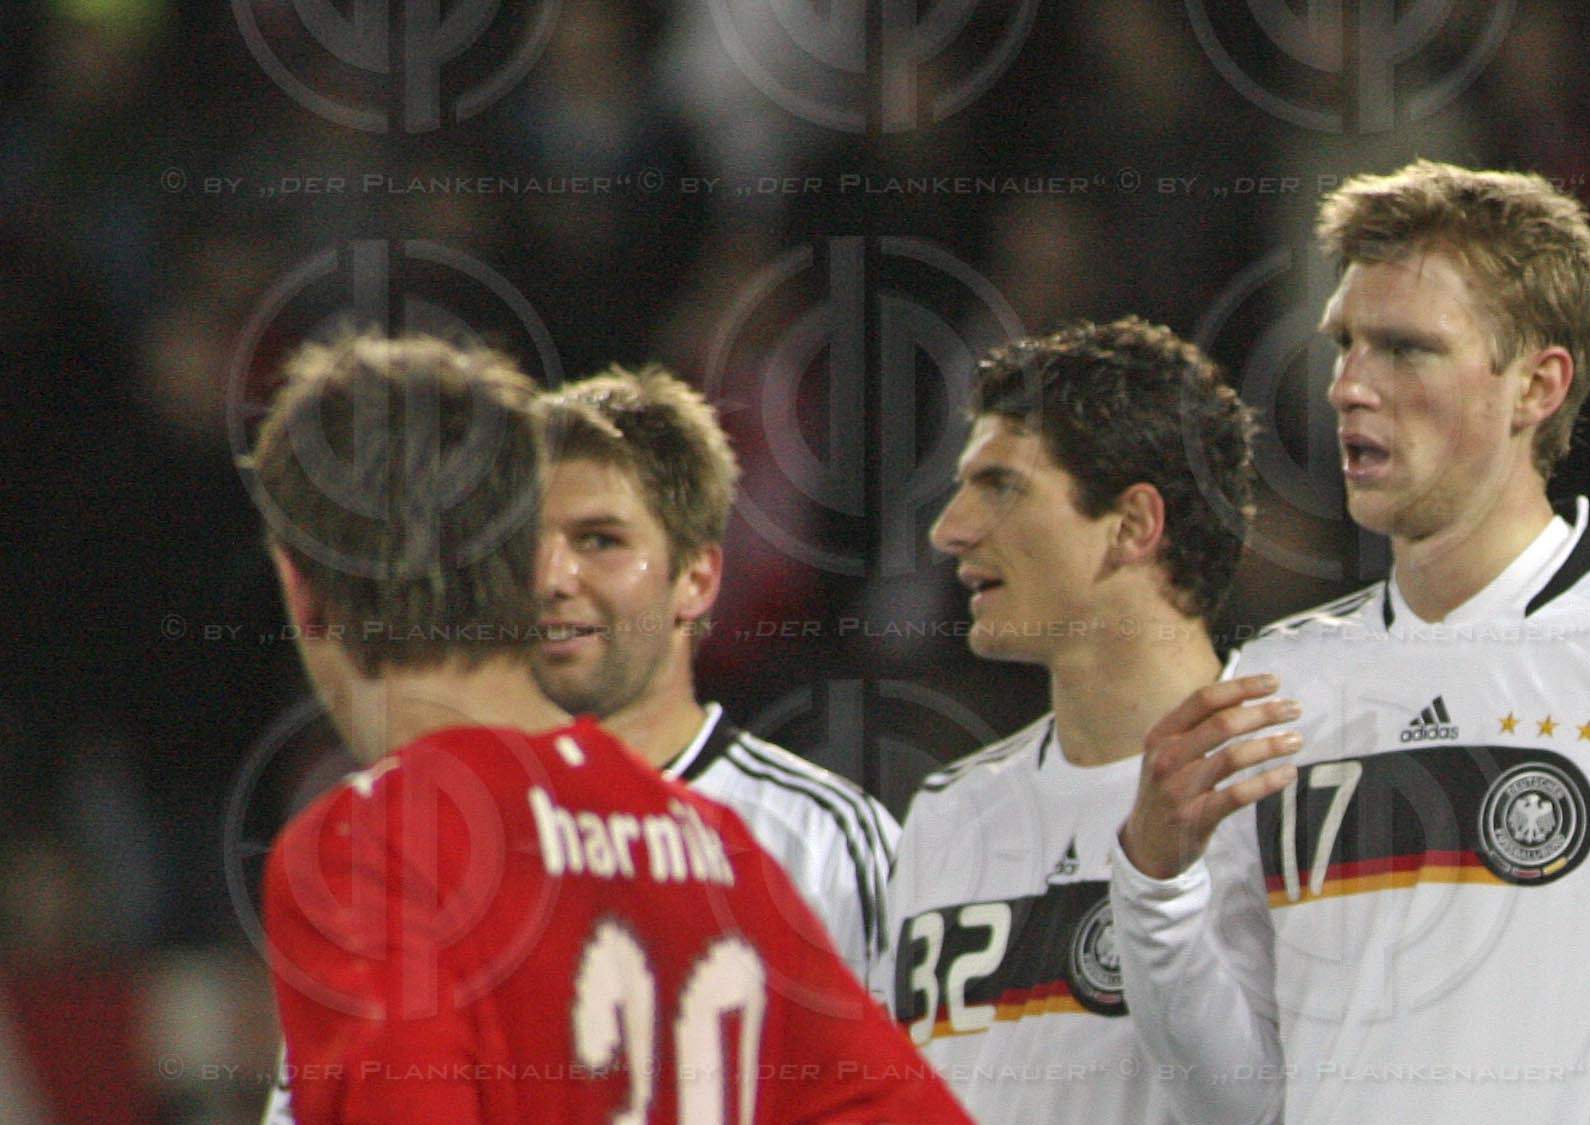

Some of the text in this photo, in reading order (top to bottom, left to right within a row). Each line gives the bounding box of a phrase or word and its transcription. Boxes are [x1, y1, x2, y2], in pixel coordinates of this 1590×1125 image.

[1401, 725, 1459, 742] adidas
[1280, 760, 1362, 902] 17
[909, 902, 1012, 1044] 32
